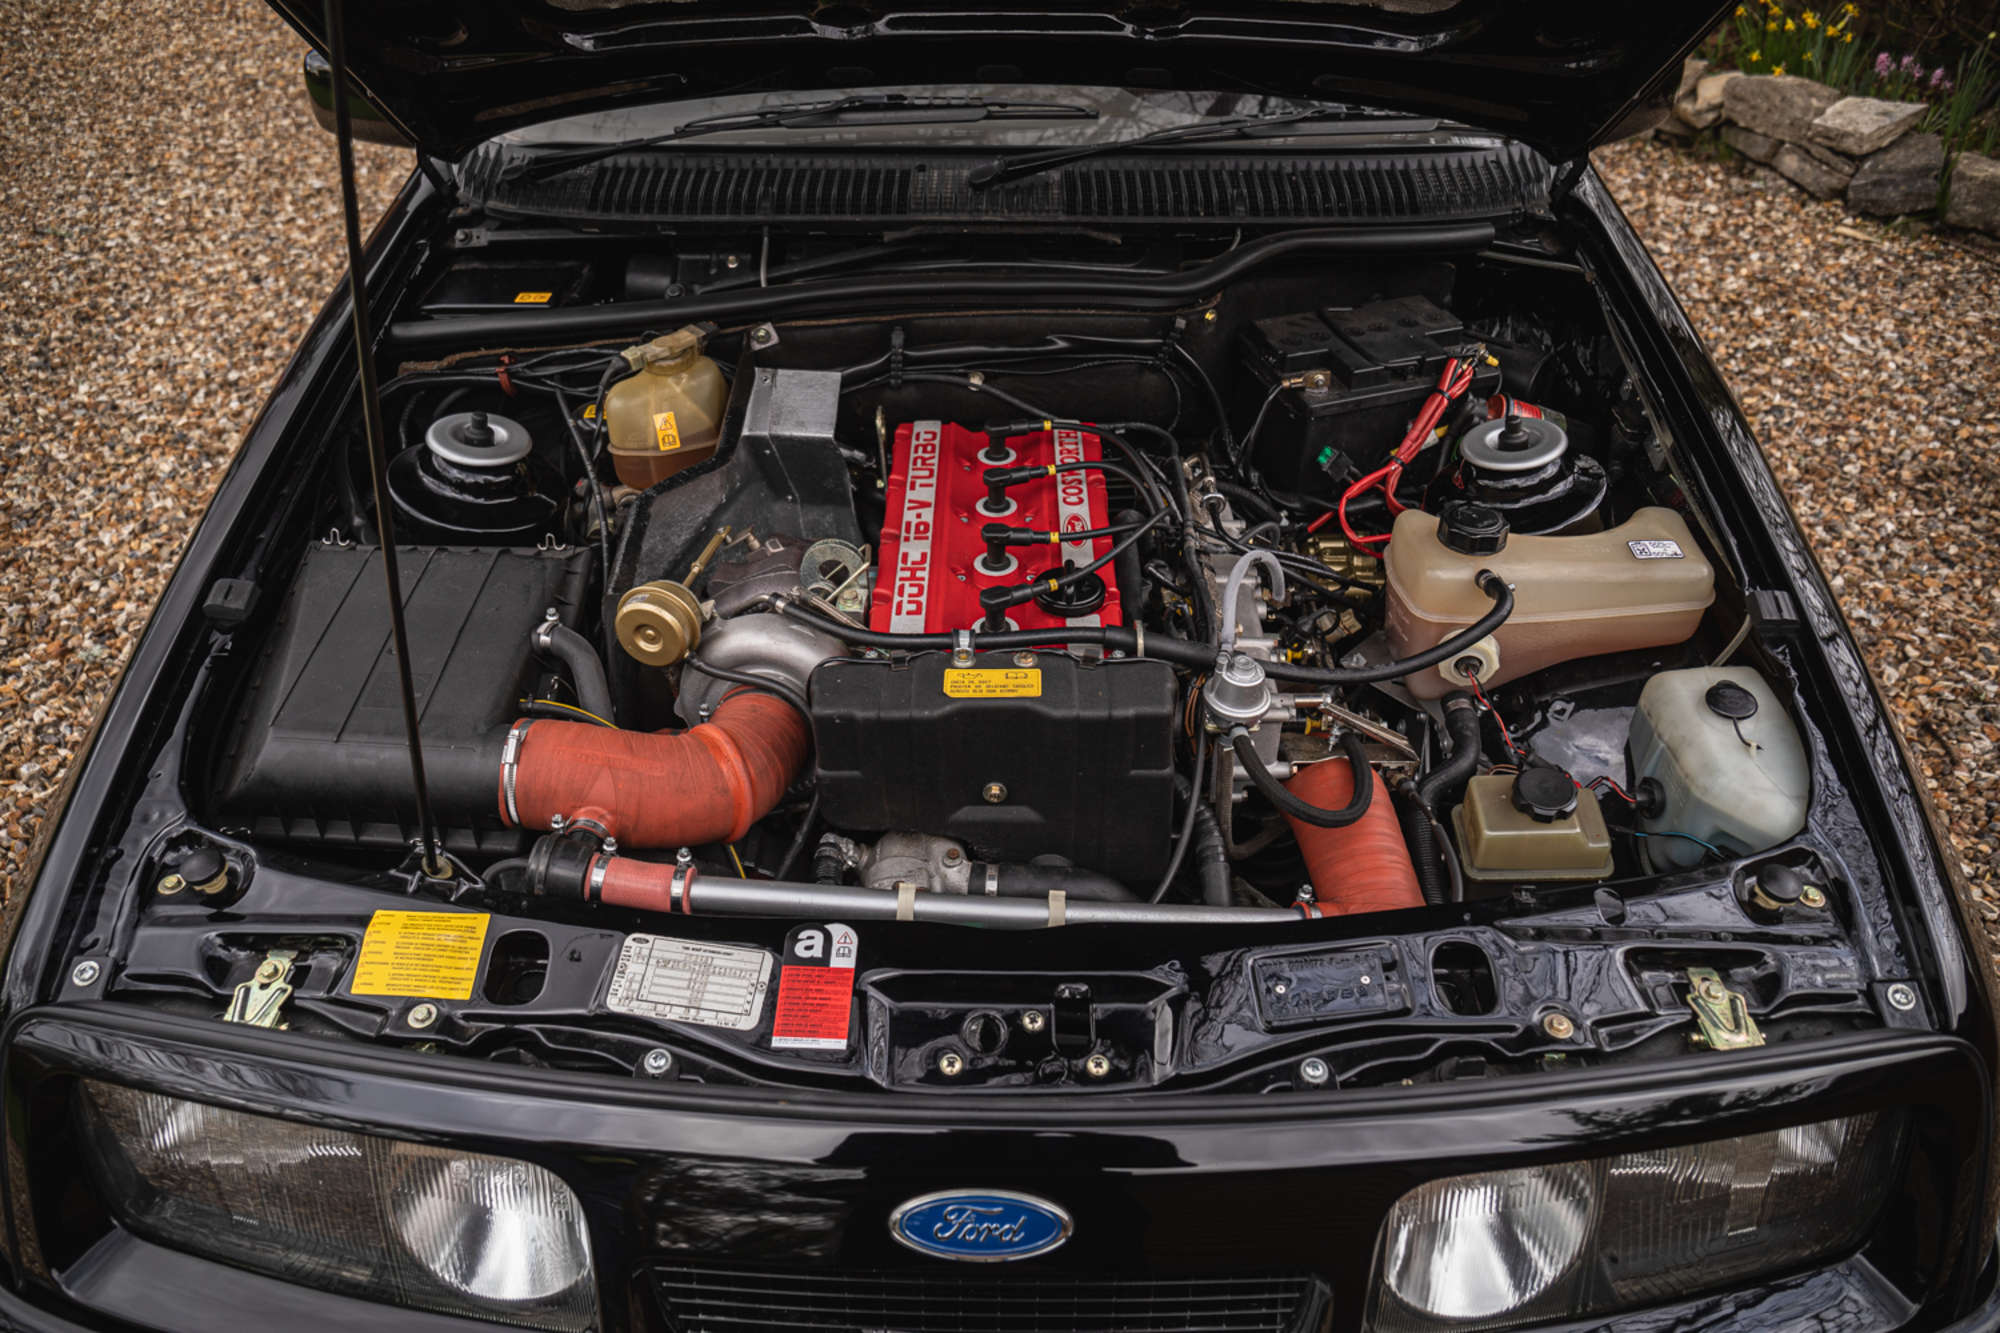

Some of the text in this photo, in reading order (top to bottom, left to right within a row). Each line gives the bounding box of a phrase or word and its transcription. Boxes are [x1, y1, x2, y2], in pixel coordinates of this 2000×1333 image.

[909, 431, 937, 491] TURBO
[895, 552, 928, 616] DOHC
[794, 929, 824, 958] a
[933, 1204, 1027, 1243] Ford
